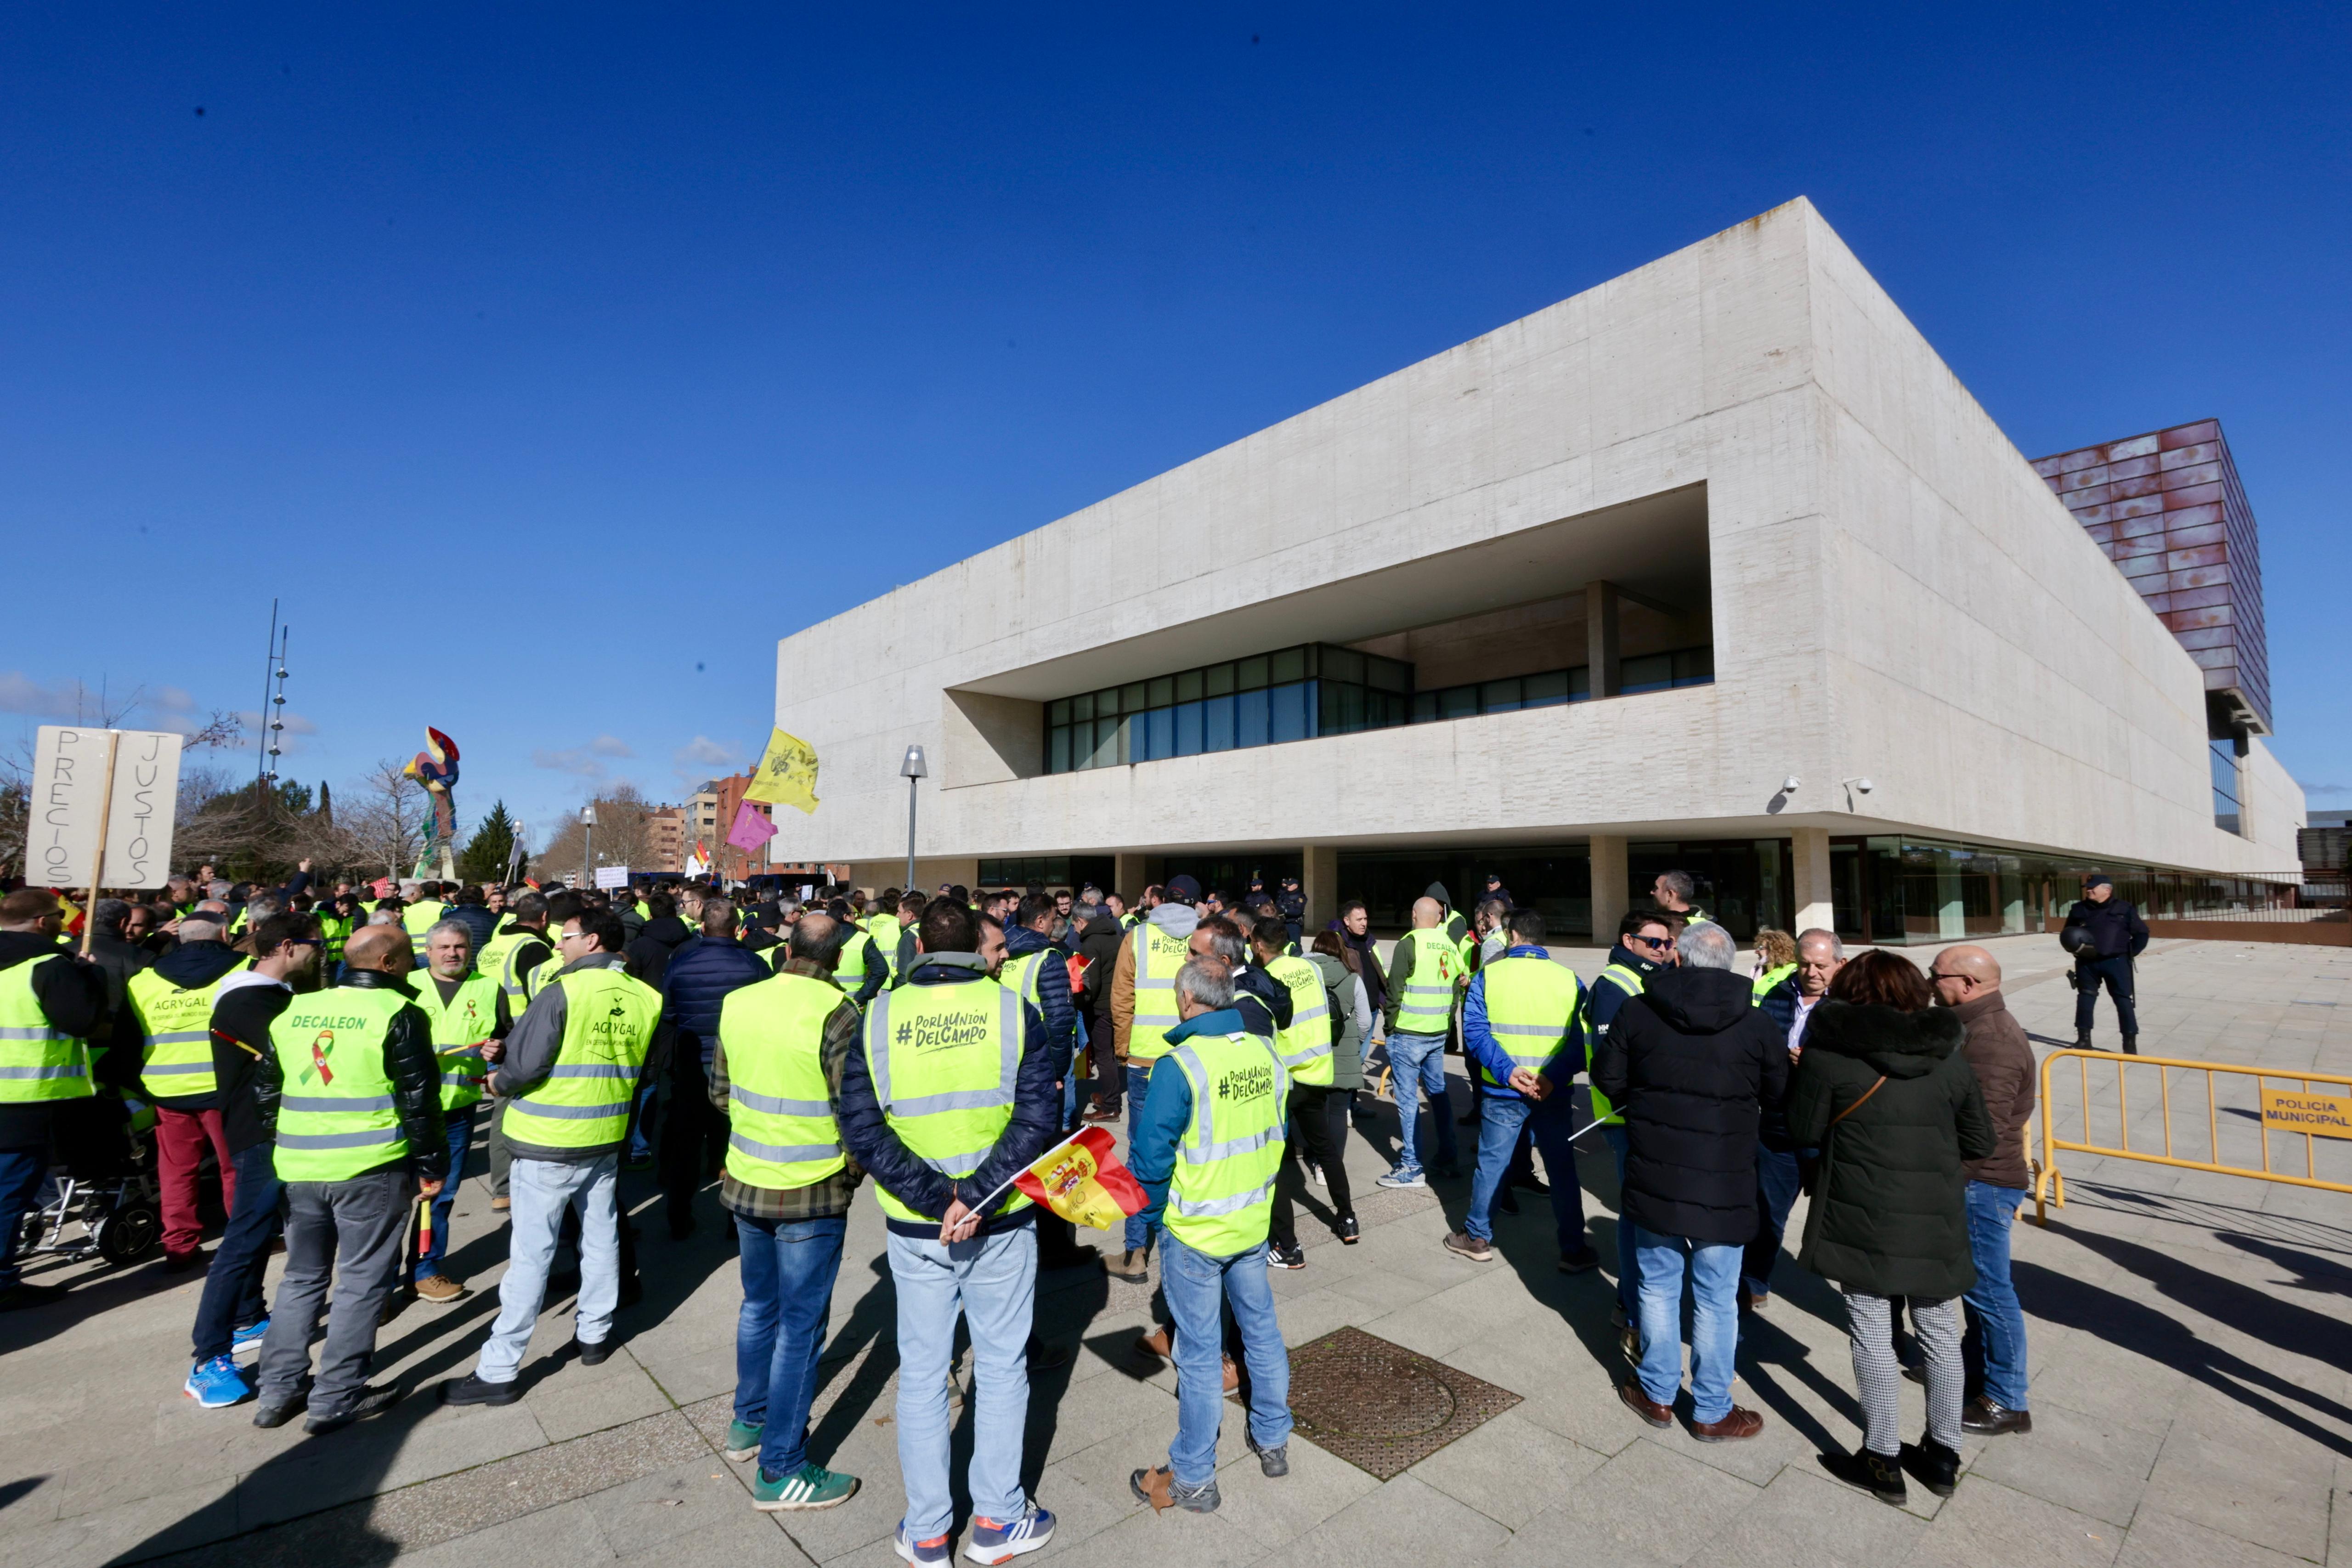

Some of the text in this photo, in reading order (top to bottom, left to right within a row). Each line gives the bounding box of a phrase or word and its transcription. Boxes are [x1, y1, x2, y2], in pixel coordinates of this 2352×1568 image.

[45, 730, 79, 883] PRECIOS
[129, 735, 168, 884] JUSTOS
[1163, 944, 1187, 954] DELCA
[154, 997, 208, 1011] AGRYGAL
[291, 1015, 367, 1030] DECALEON
[591, 1022, 636, 1036] AGRYGAL
[916, 1025, 987, 1047] DELCAMPO
[1233, 1078, 1272, 1100] DELCAMPO
[2266, 1109, 2352, 1126] MUNICIPAL
